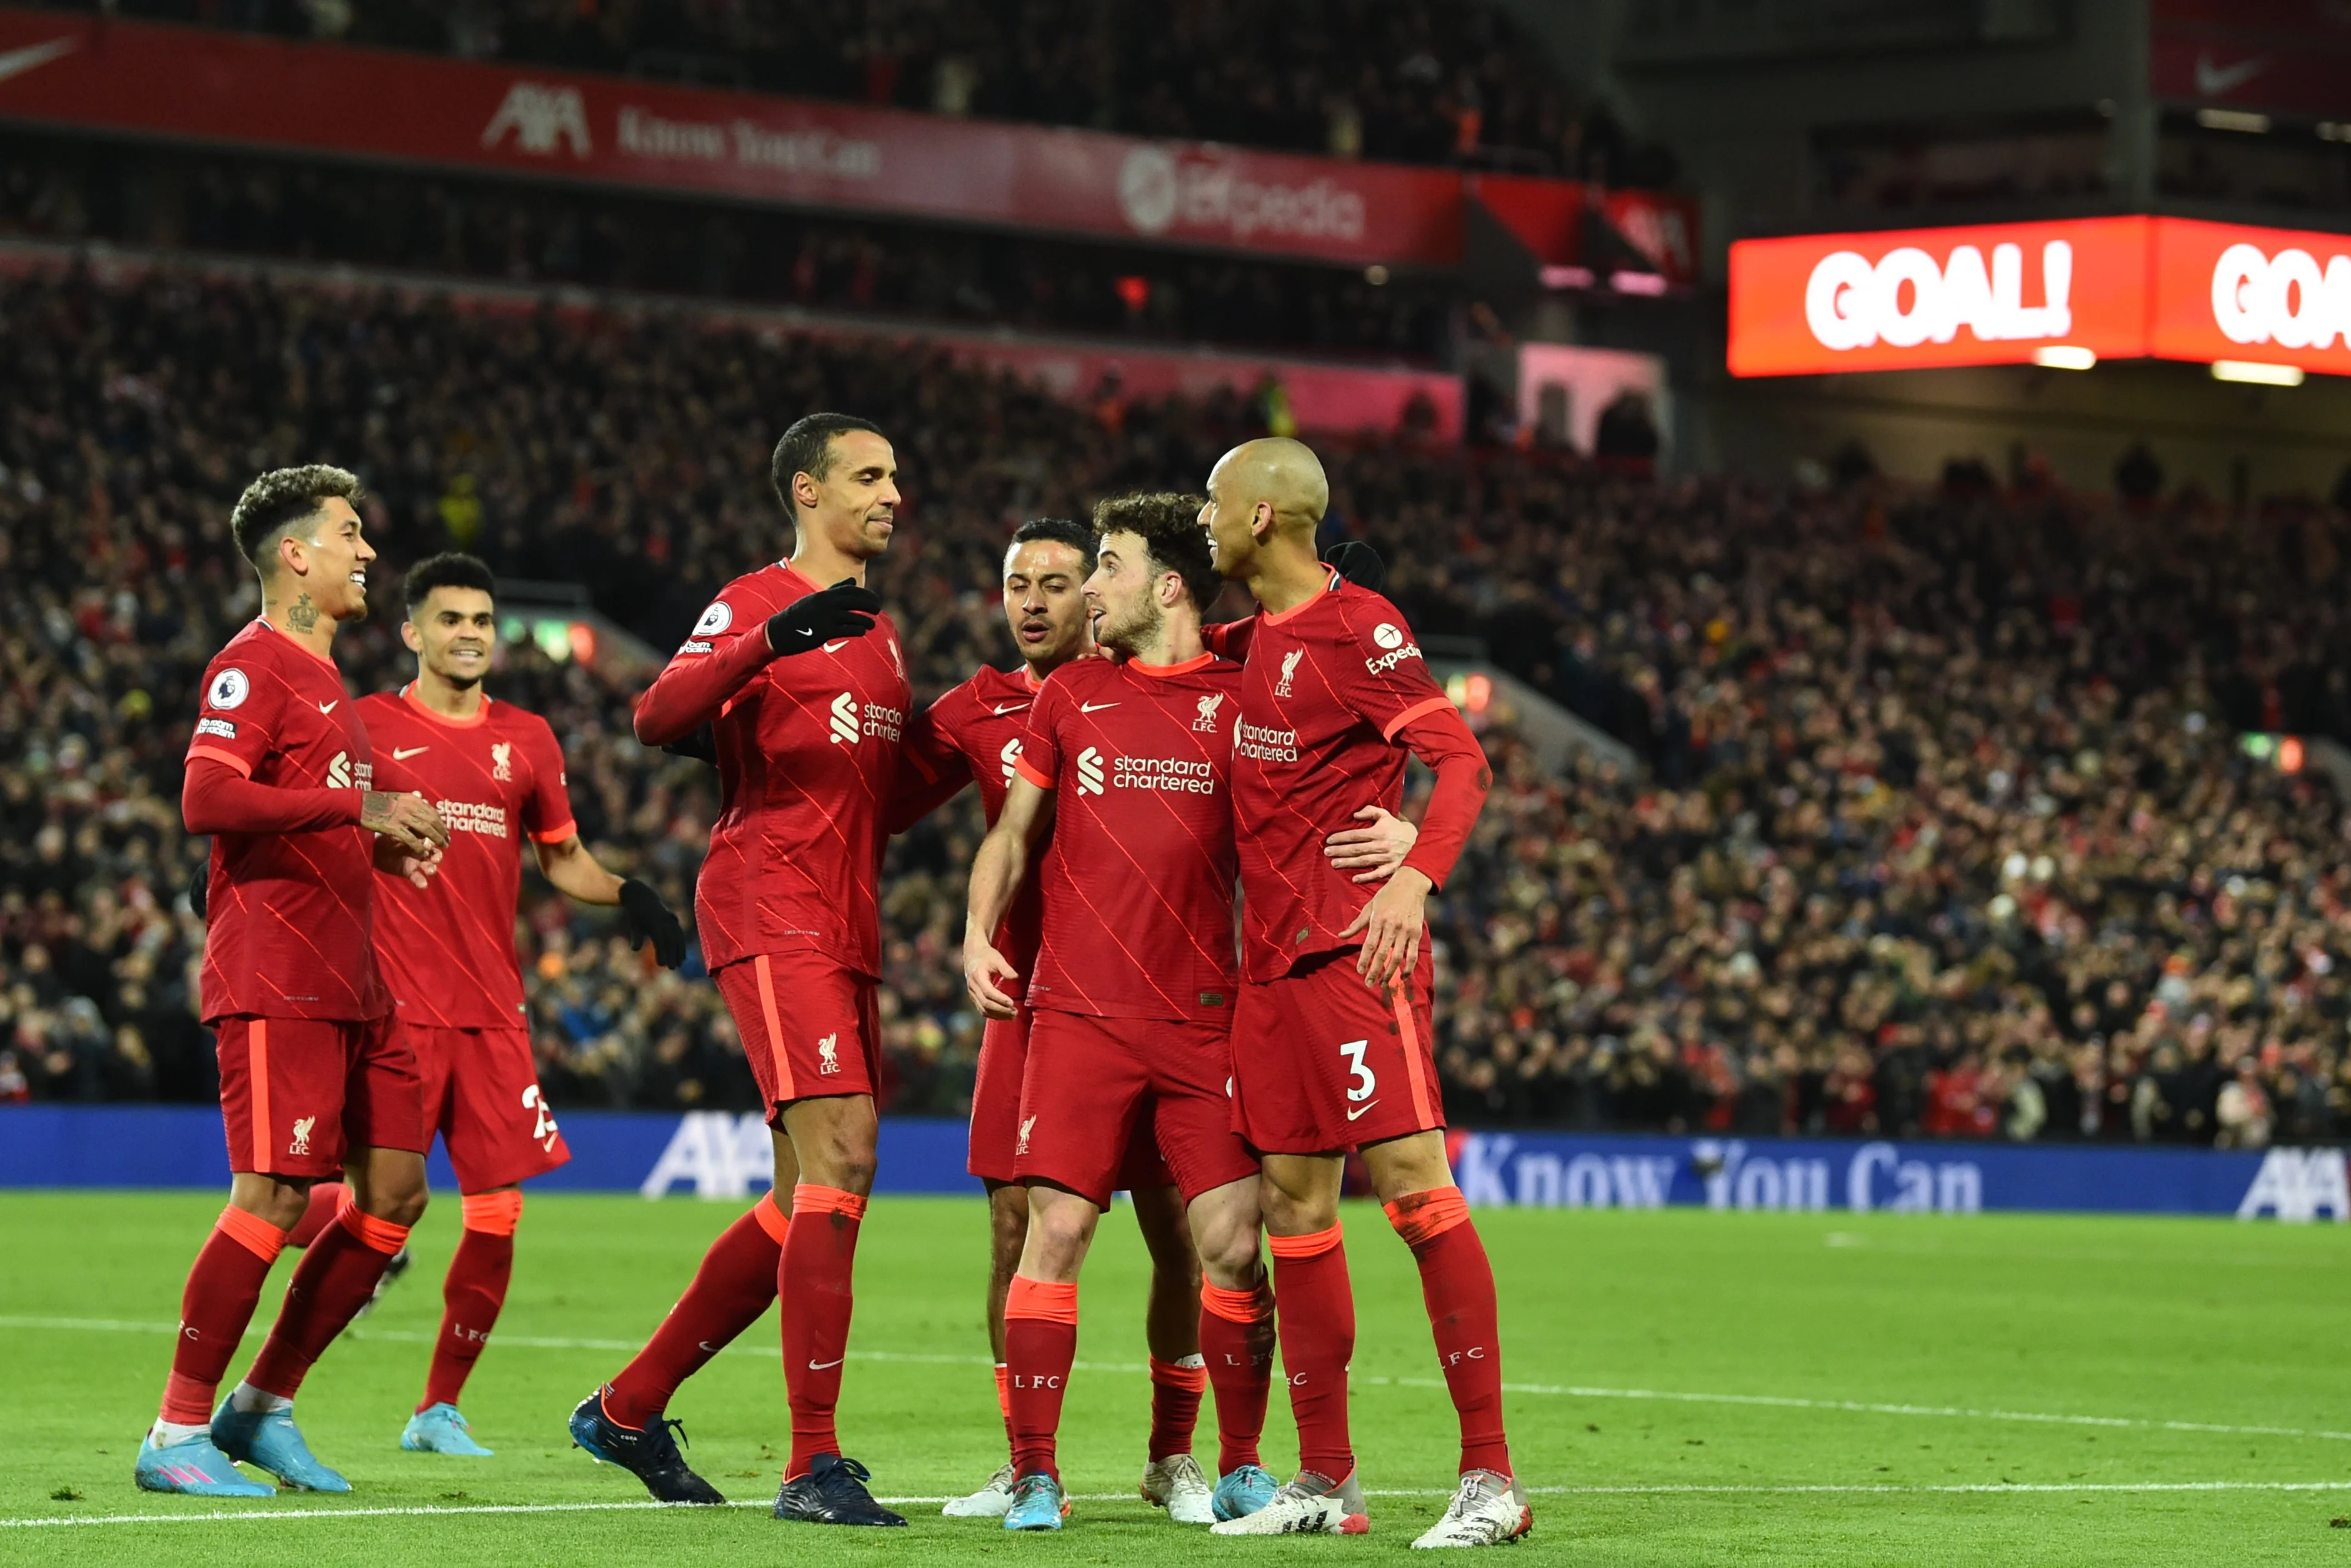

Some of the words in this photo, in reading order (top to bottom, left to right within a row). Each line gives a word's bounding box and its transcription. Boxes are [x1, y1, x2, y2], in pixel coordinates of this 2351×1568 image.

[481, 82, 592, 161] AXA
[1805, 240, 2072, 351] GOAL!
[1240, 740, 1297, 762] chartered
[1242, 721, 1295, 746] standard
[1113, 772, 1214, 795] chartered
[1114, 754, 1211, 777] standard
[436, 799, 506, 823] standard
[1340, 1039, 1376, 1102] 3
[640, 1109, 775, 1200] AXA
[1461, 1132, 1677, 1210] Know
[1690, 1137, 1829, 1212] You
[1846, 1141, 1982, 1214] Can
[2234, 1145, 2350, 1223] AXA
